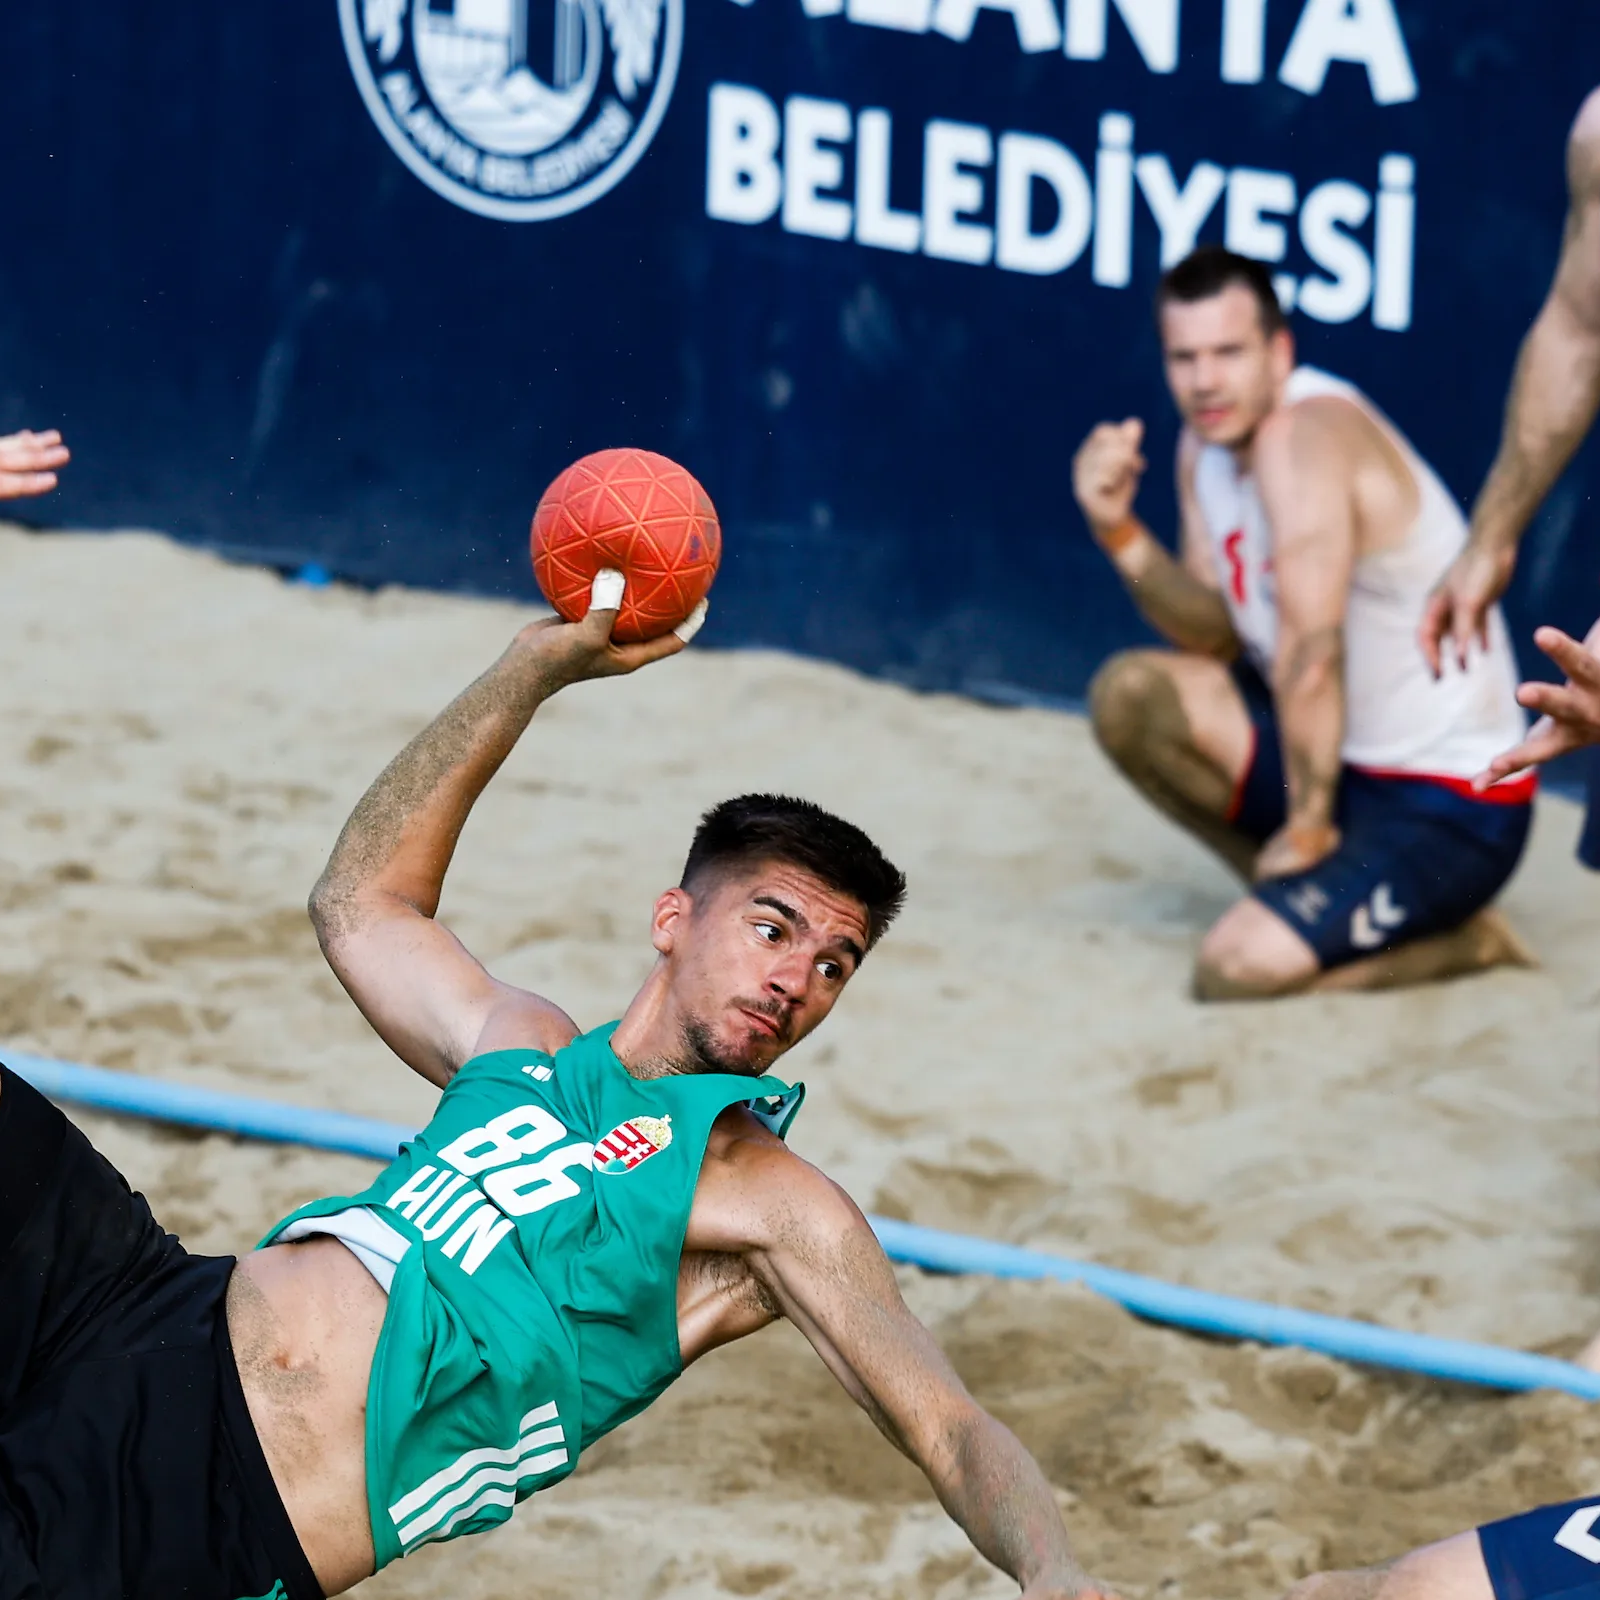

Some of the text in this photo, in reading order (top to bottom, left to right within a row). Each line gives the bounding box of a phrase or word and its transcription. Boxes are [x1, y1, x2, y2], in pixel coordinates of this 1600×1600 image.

[705, 82, 1415, 331] BELEDİYESİ
[436, 1104, 596, 1217] 86
[385, 1164, 516, 1277] HUN
